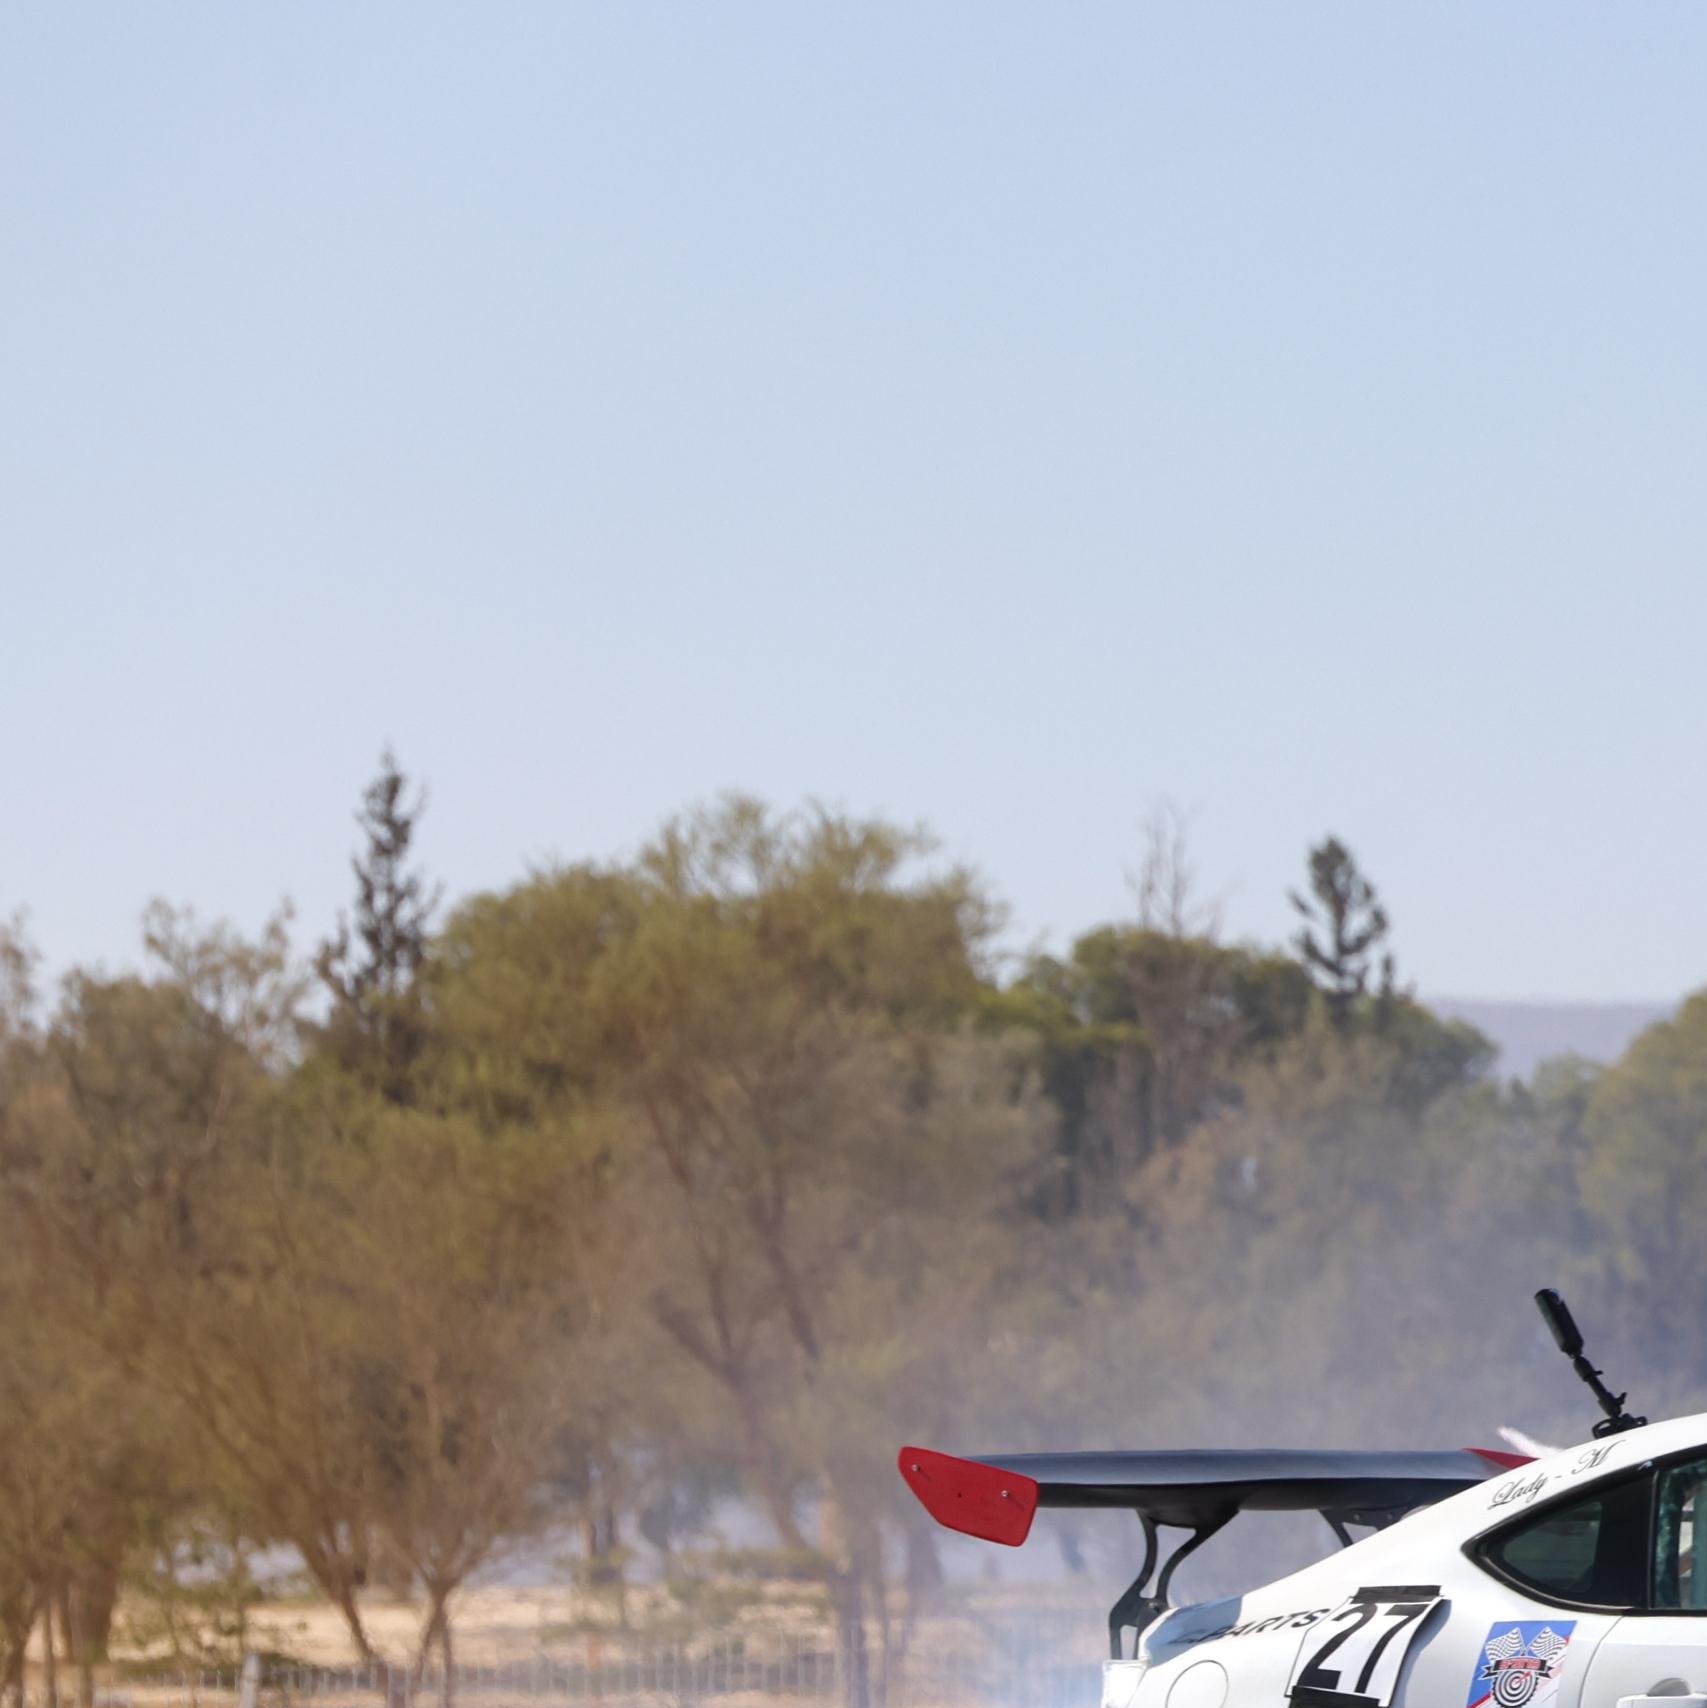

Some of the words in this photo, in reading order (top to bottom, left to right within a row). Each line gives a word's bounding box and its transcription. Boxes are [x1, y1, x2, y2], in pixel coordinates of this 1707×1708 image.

[1486, 1472, 1549, 1511] Lady
[1570, 1439, 1627, 1476] M
[1296, 1601, 1431, 1693] 27
